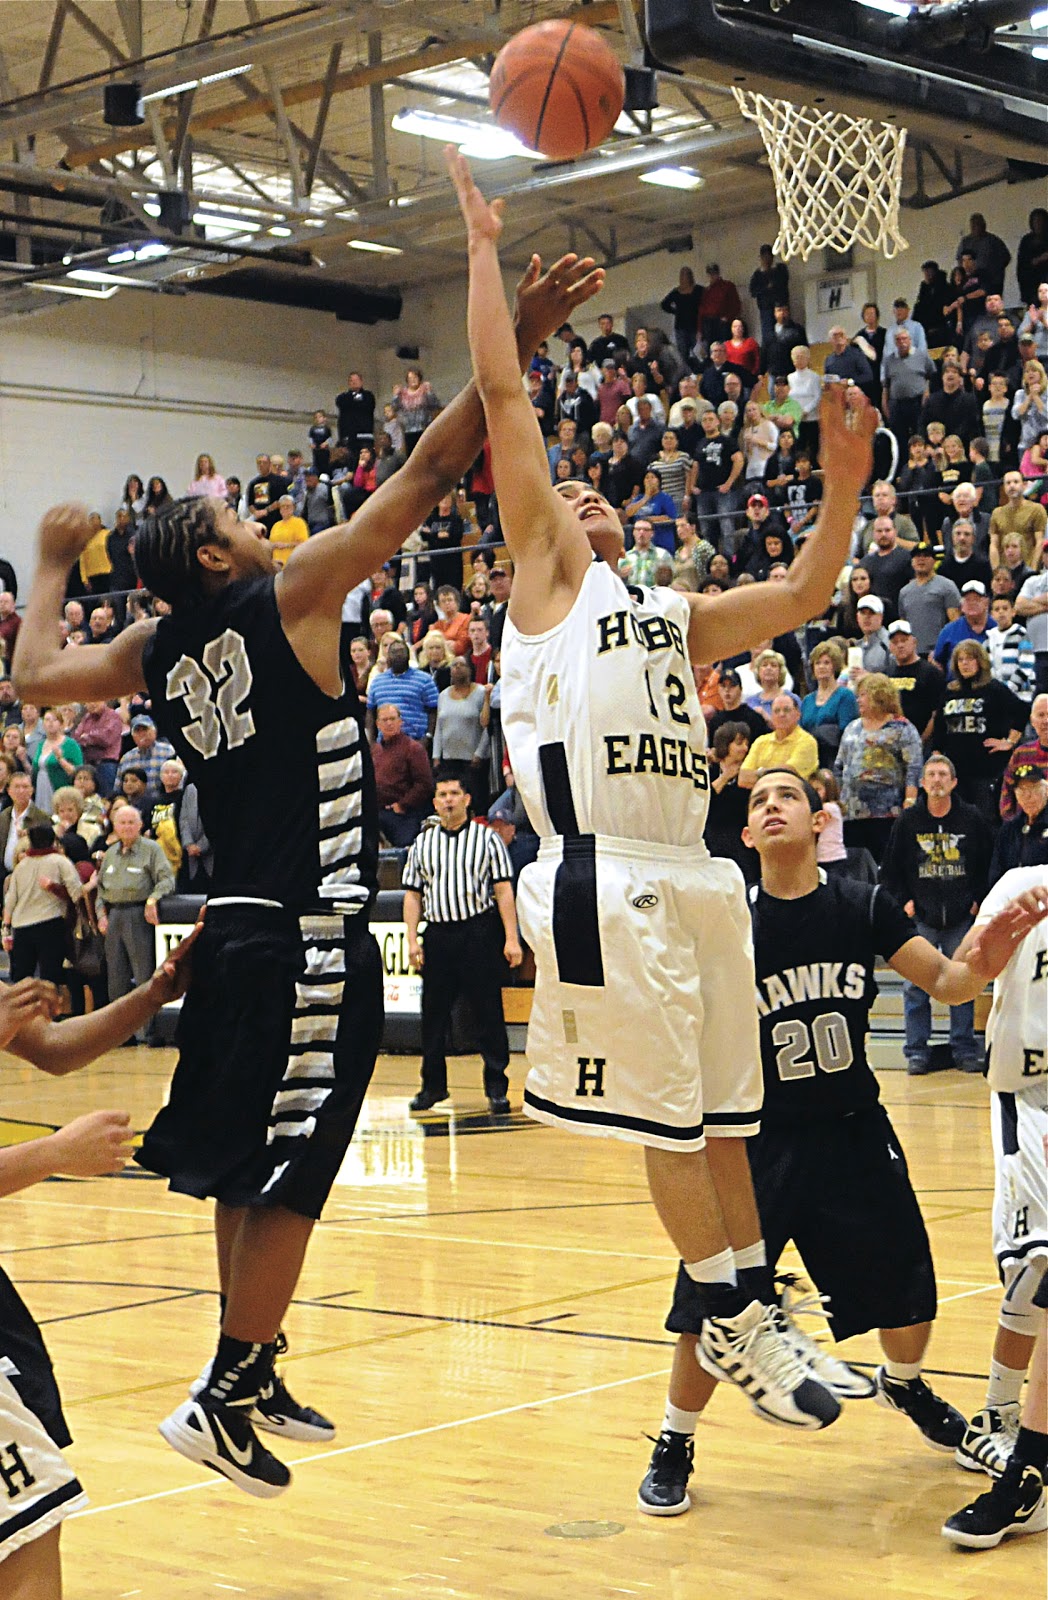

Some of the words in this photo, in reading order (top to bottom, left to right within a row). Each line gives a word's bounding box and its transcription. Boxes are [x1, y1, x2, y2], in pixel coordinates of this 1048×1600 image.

[829, 287, 842, 309] H
[166, 627, 256, 760] 32
[645, 668, 691, 725] 12
[771, 1011, 854, 1081] 20
[576, 1056, 606, 1097] H
[1012, 1205, 1030, 1239] H
[0, 1441, 36, 1499] H
